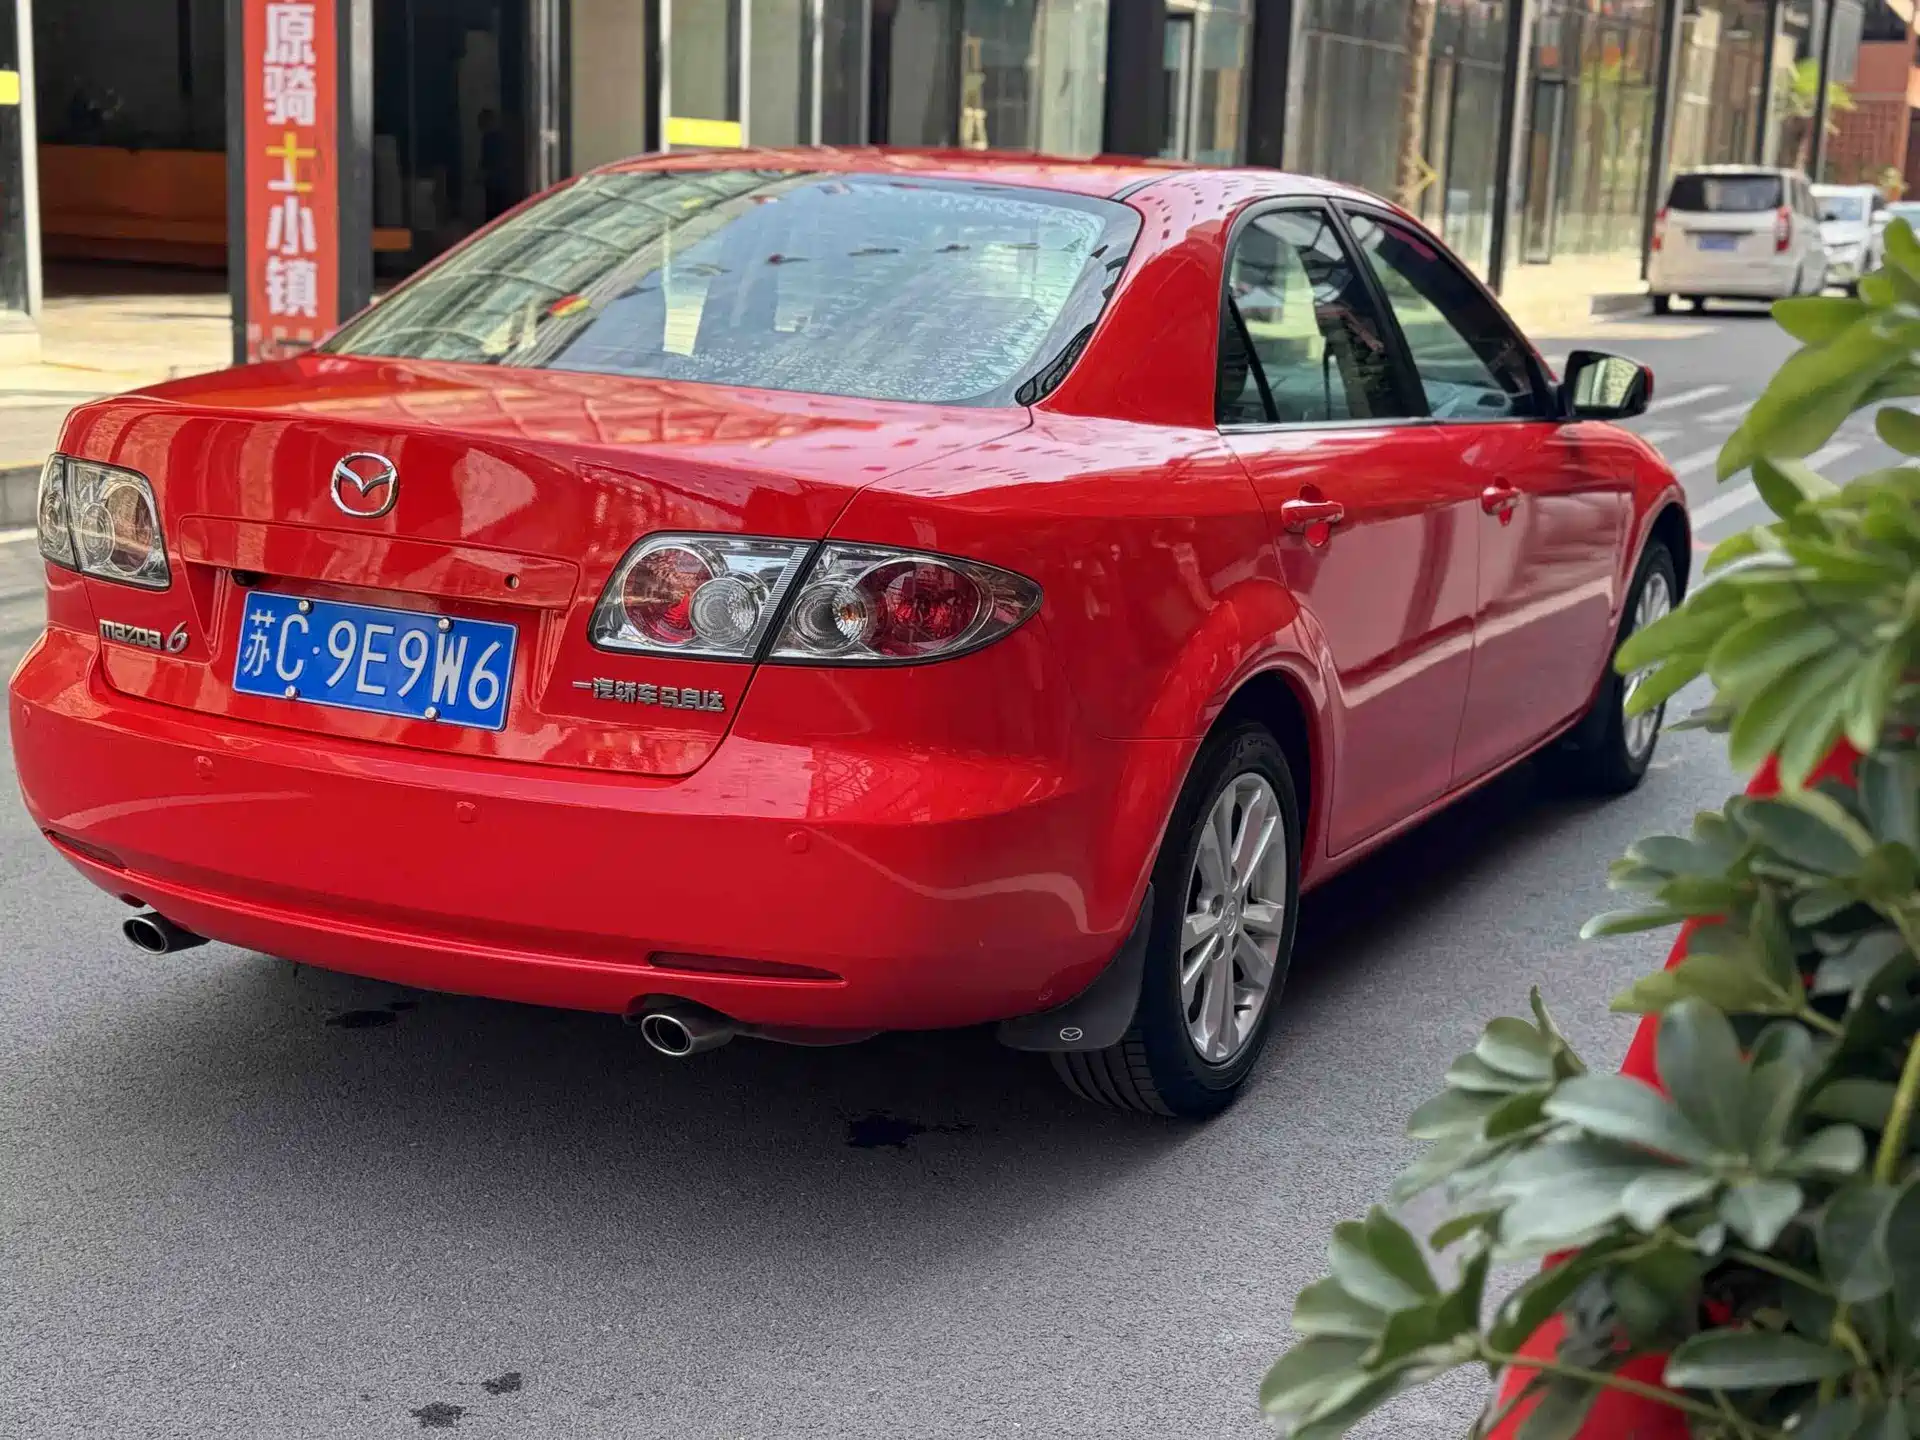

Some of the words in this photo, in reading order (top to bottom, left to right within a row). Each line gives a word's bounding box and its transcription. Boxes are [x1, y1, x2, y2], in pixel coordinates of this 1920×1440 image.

[263, 0, 317, 317] 原骑士小镇
[167, 620, 189, 654] 6
[243, 608, 503, 711] 苏C·9E9W6
[572, 677, 725, 712] 一汽轿车马自达
